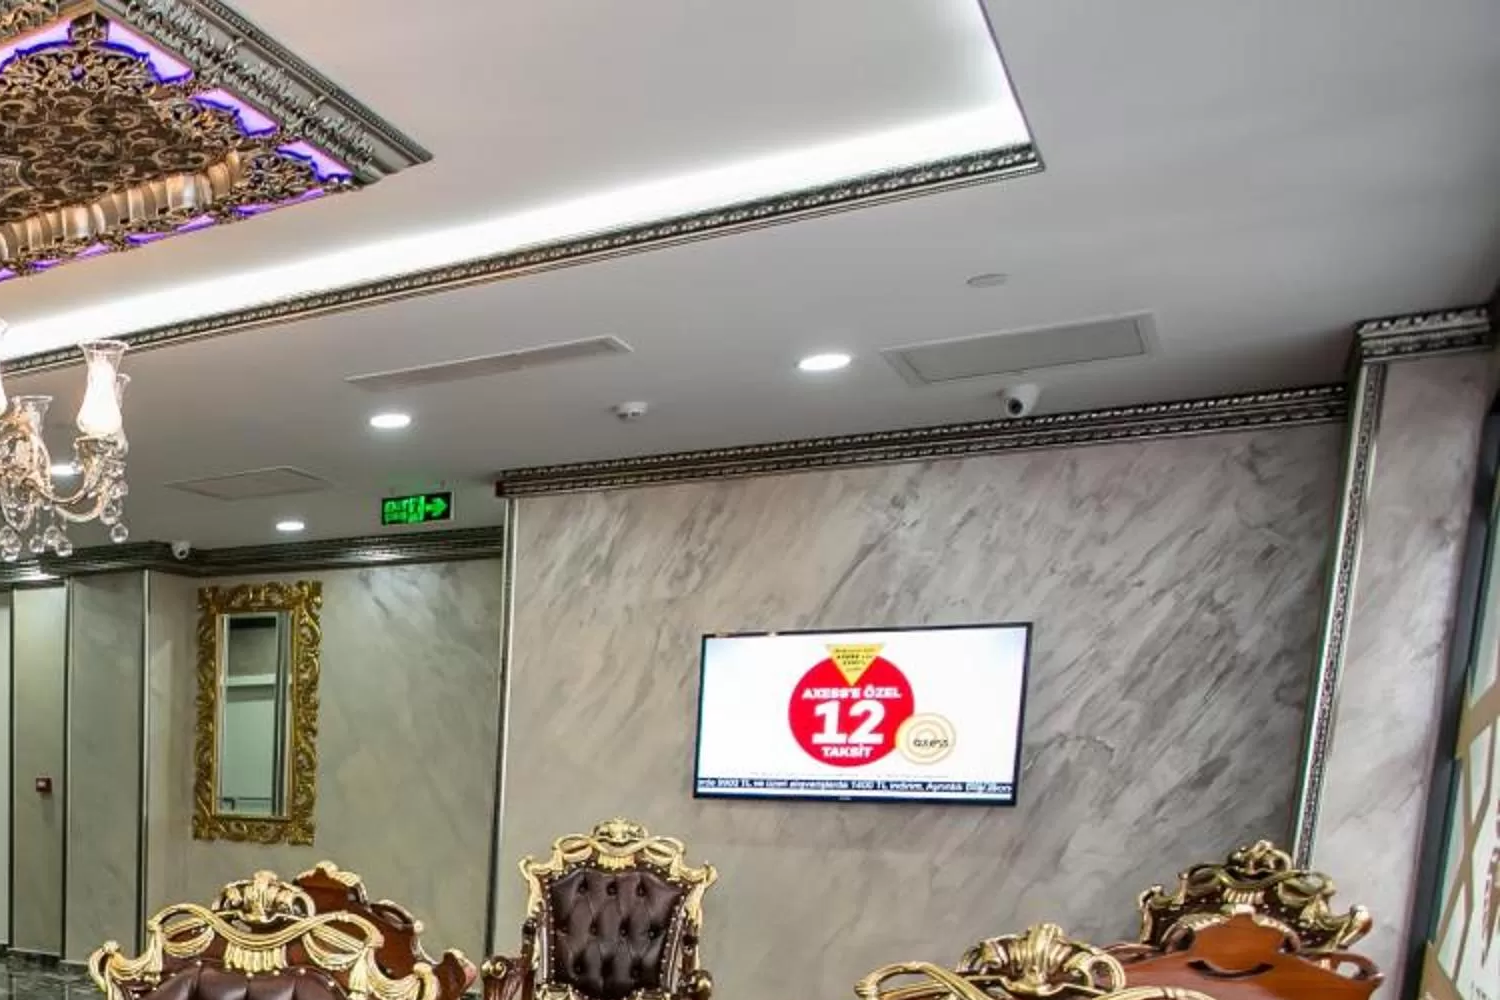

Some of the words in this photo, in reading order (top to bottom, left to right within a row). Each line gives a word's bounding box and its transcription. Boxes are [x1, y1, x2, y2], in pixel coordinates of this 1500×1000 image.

[863, 684, 903, 699] ÖZEL
[811, 699, 886, 745] 12
[821, 743, 874, 758] TAKSİT
